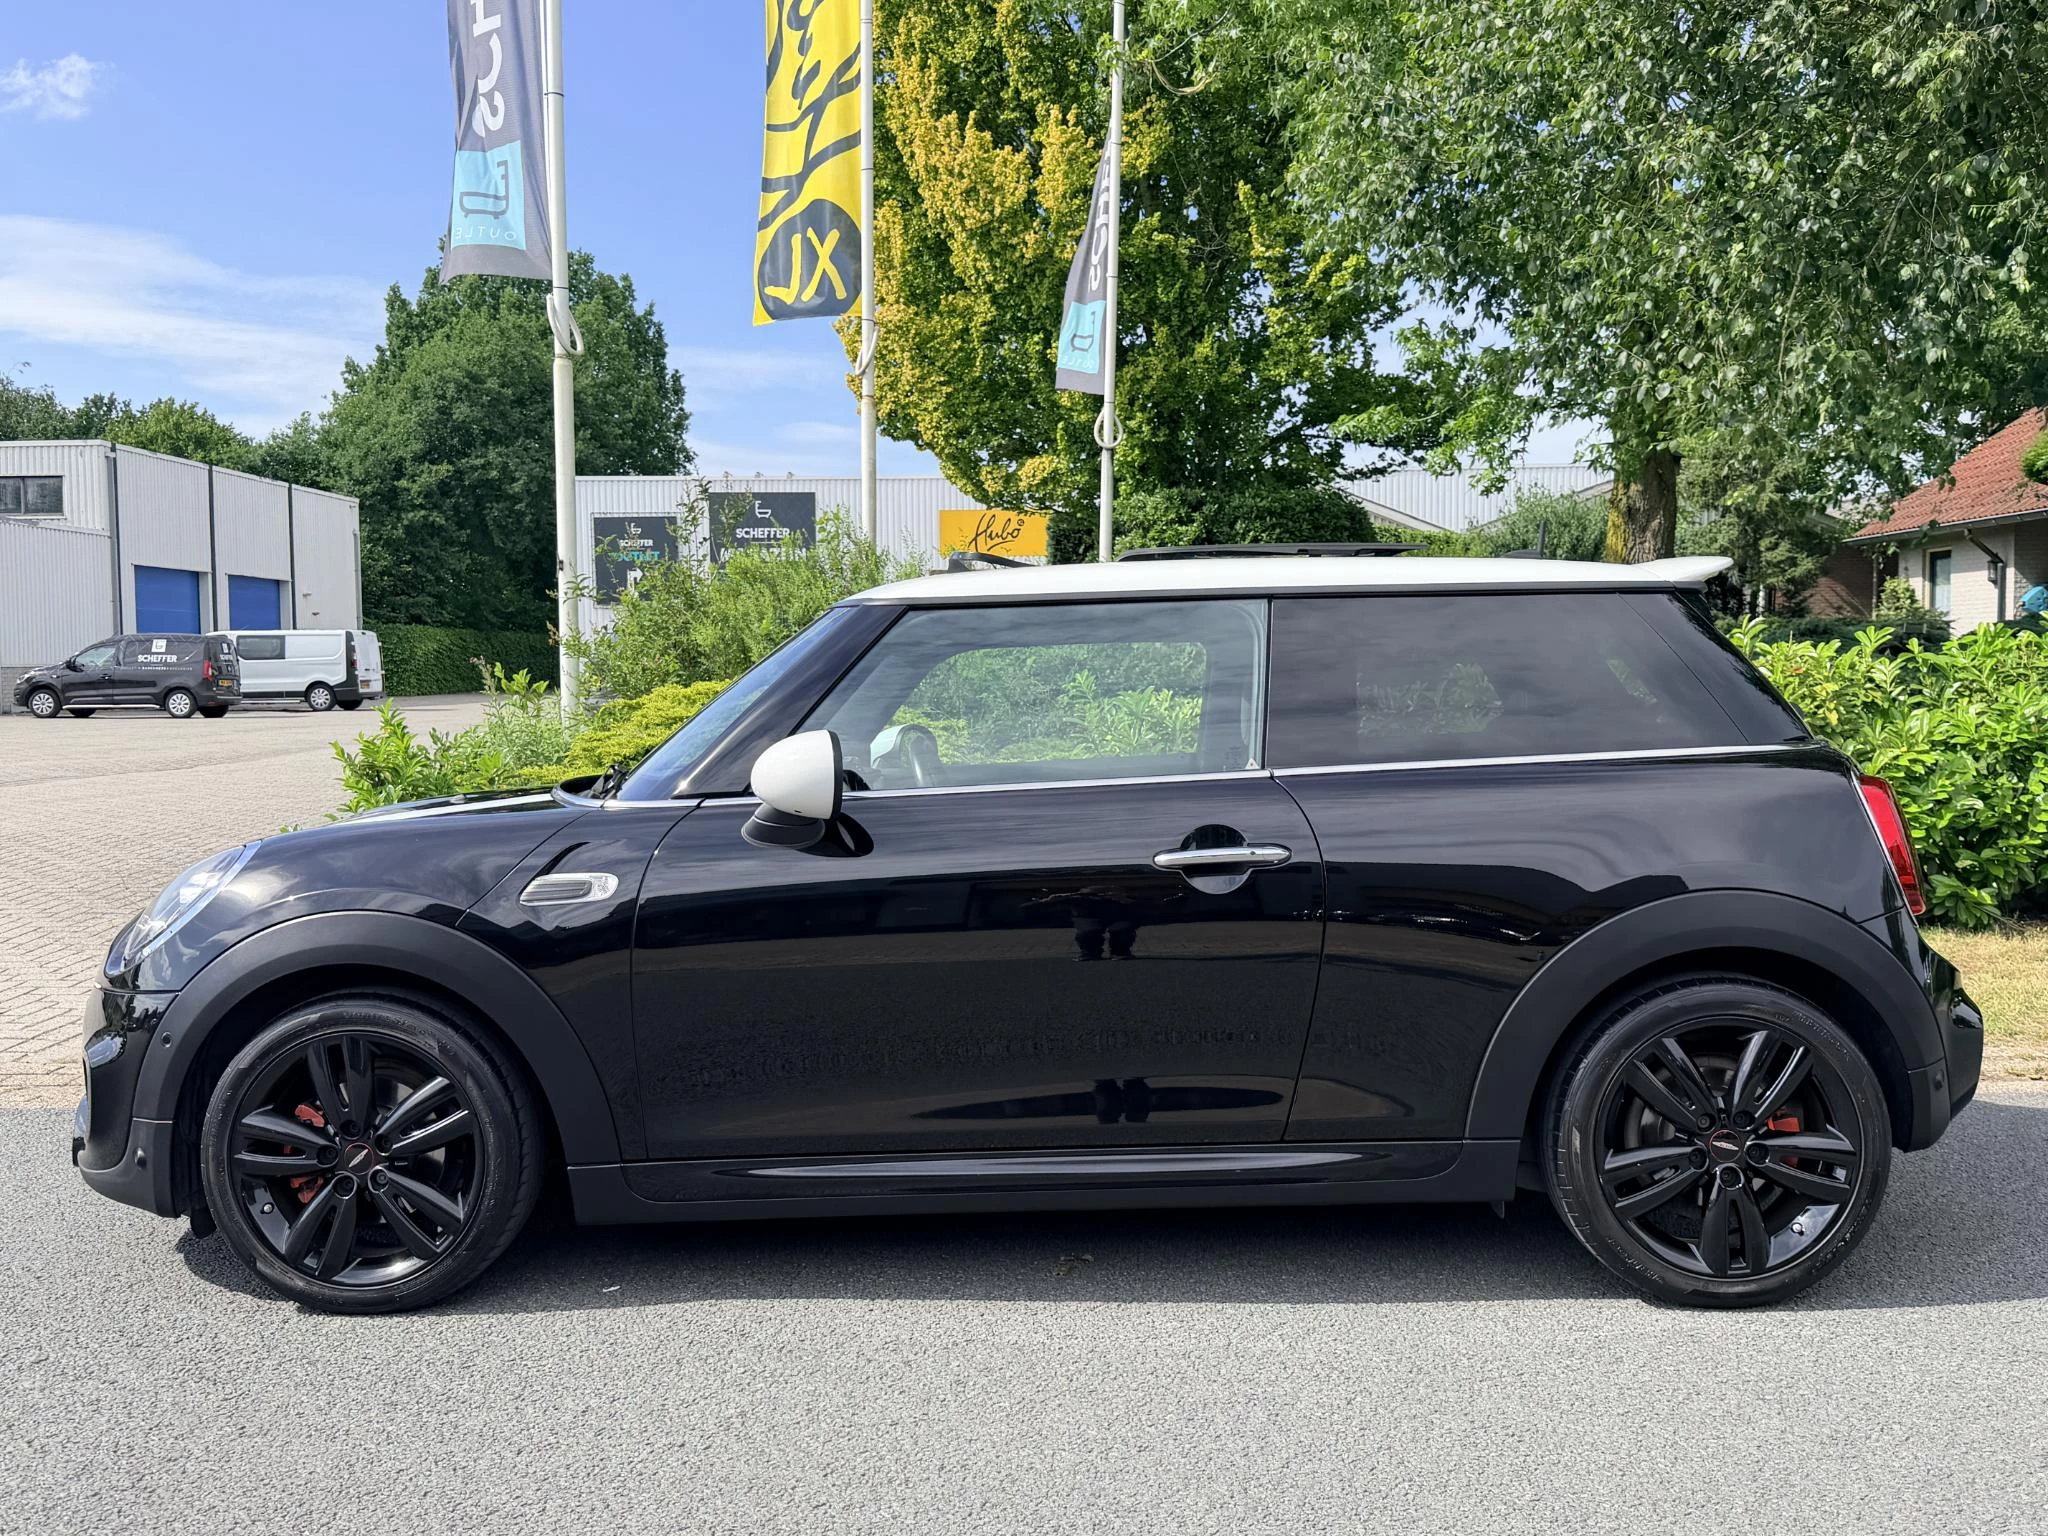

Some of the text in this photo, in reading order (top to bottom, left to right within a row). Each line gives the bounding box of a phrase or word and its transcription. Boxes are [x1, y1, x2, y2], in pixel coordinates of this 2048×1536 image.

[735, 527, 791, 539] SCHEFFER
[967, 512, 1021, 553] Hubo
[137, 654, 178, 663] SCHEFFER
